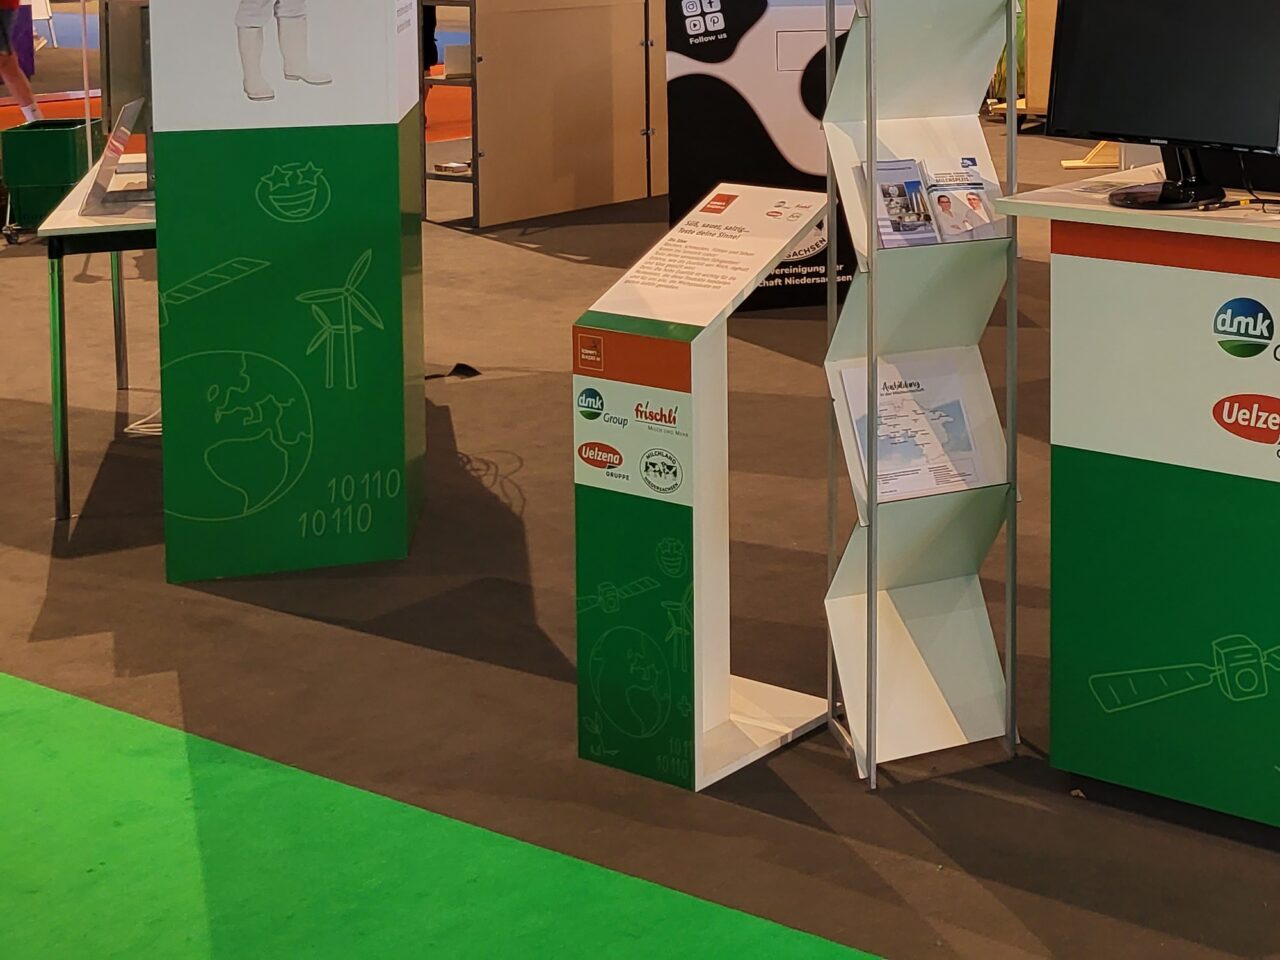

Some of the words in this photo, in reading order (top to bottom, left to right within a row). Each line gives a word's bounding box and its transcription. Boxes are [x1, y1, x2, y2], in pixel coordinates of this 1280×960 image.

[689, 34, 716, 45] Follow
[785, 275, 852, 285] Niedersasen
[1216, 308, 1271, 337] dmk
[578, 392, 603, 408] dmk
[603, 413, 628, 428] Group
[582, 446, 620, 464] Uelzena
[646, 450, 676, 465] MILCHLAND
[606, 471, 629, 481] GRUPPE
[644, 476, 678, 492] NIEDERSACHSEN
[328, 469, 400, 503] 10110
[299, 503, 372, 538] 10110
